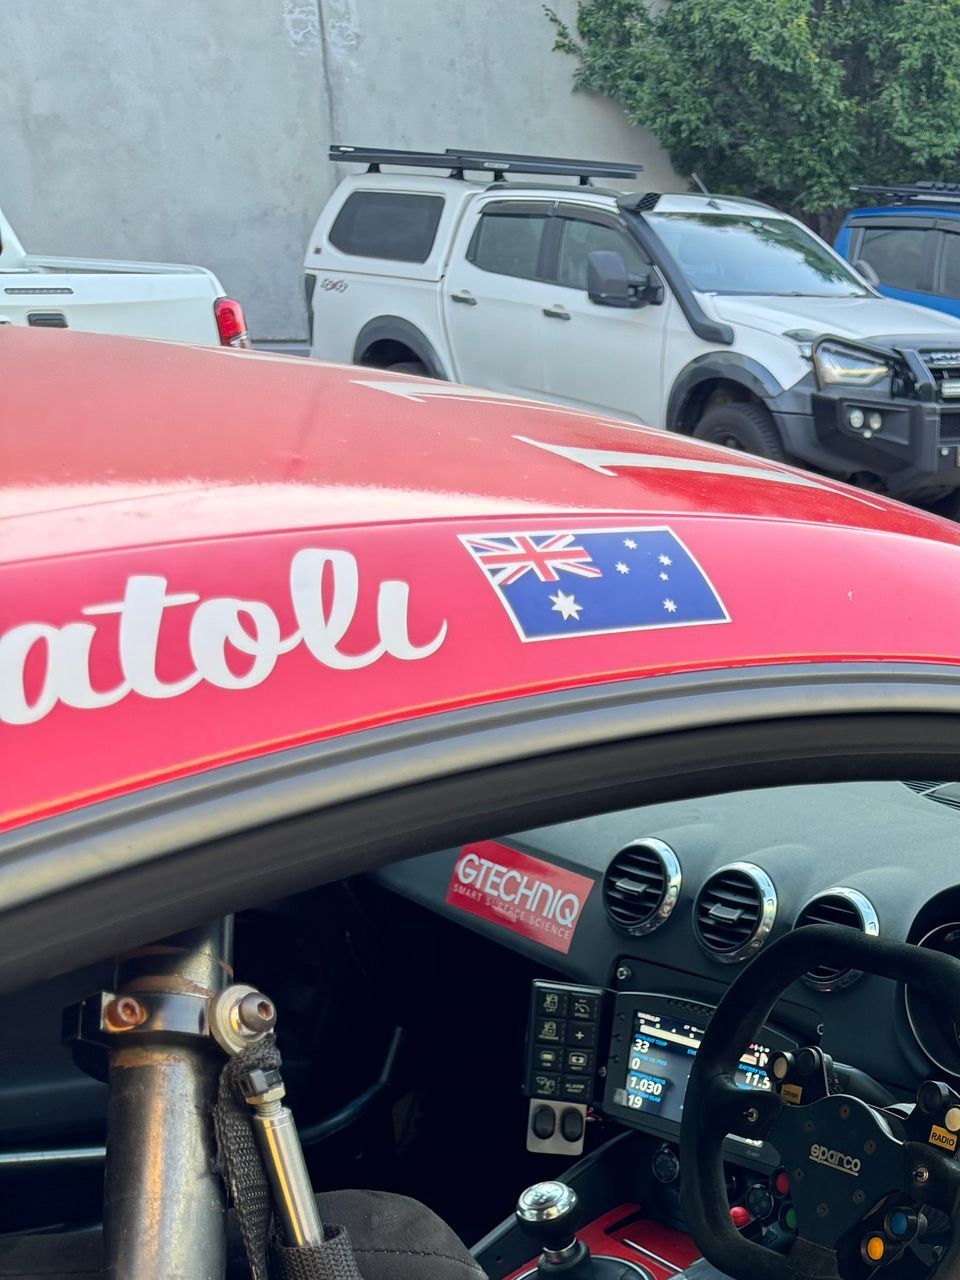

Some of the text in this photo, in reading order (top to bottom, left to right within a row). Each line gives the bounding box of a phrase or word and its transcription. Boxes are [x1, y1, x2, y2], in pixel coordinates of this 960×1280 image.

[457, 853, 580, 928] GTECHNIQ
[453, 883, 483, 902] SMART
[528, 915, 571, 940] SCIENCE
[634, 1038, 650, 1054] 33
[631, 1057, 640, 1070] 0
[630, 1075, 663, 1096] 1.030
[744, 1071, 771, 1090] 11.5
[627, 1094, 643, 1110] 19
[931, 1131, 955, 1147] RADIO
[810, 1143, 861, 1172] sparco
